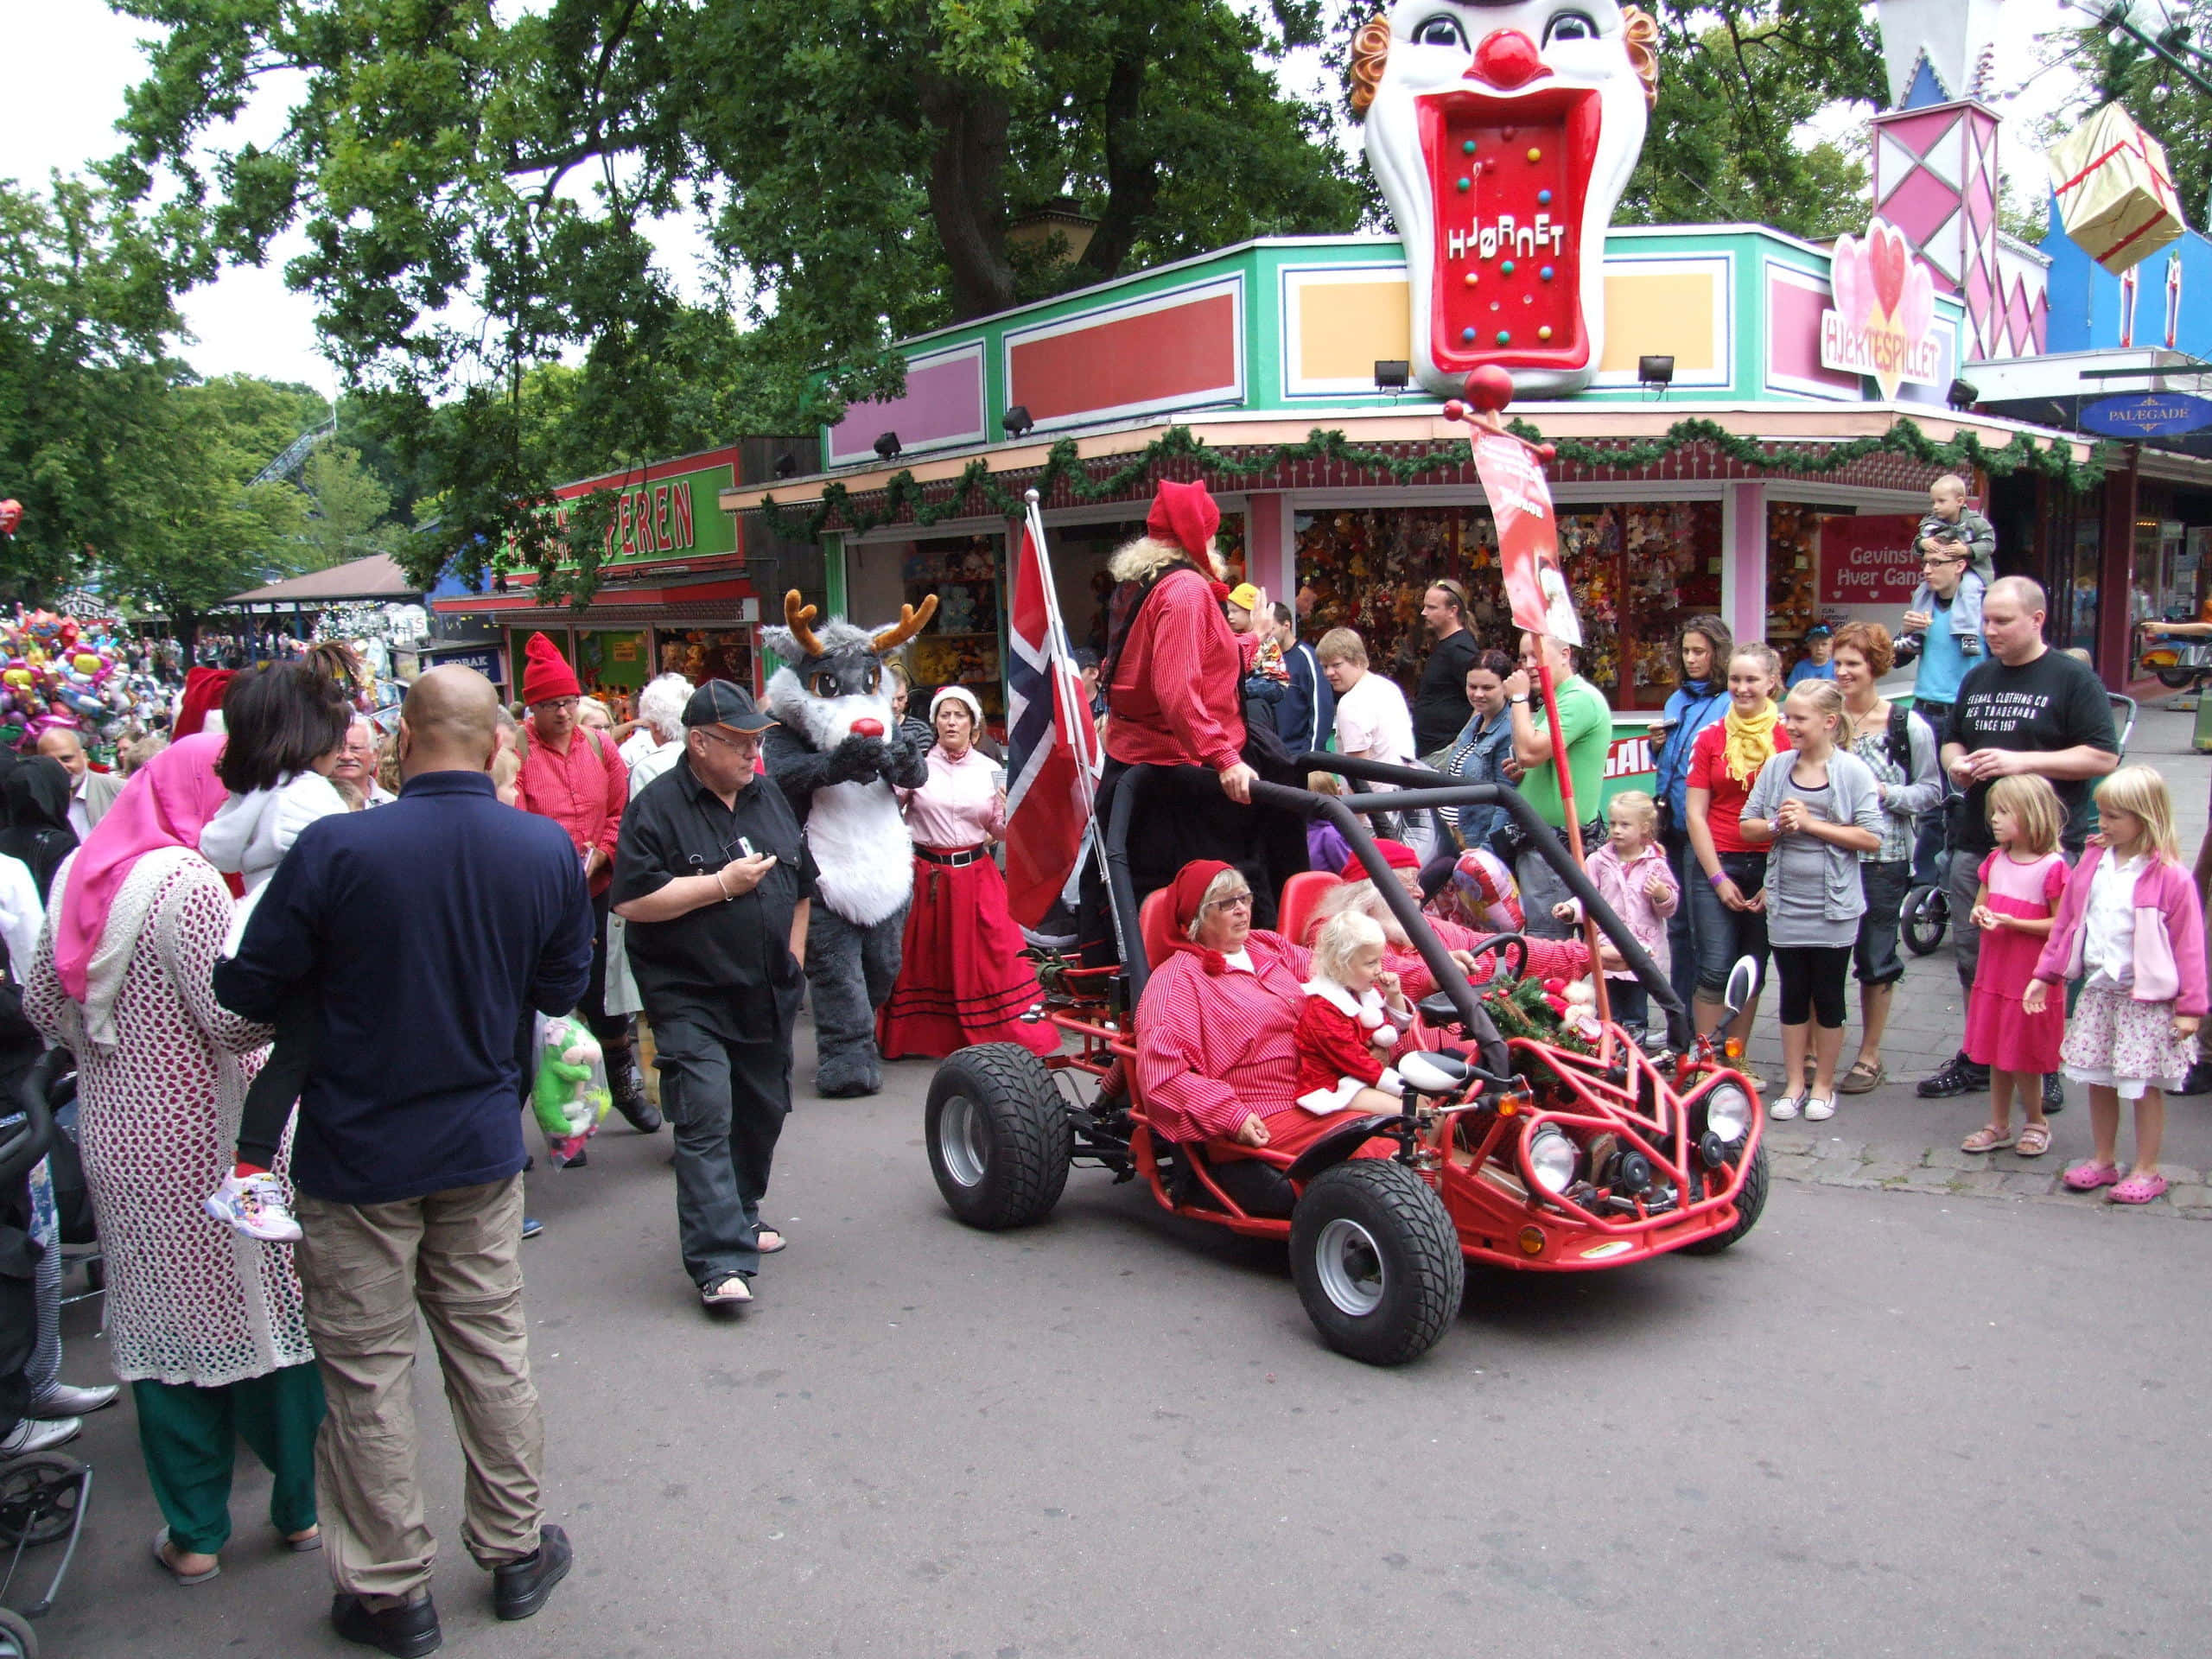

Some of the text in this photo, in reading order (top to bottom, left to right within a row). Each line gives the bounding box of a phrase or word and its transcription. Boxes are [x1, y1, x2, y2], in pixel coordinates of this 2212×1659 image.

[1448, 213, 1564, 259] HJØRNET
[1826, 317, 1939, 379] HJERTESPILLET
[2108, 408, 2190, 422] PALÆGADE
[1837, 569, 1878, 586] Hver
[1995, 692, 2032, 705] CLOTHING
[2034, 696, 2049, 708] CO
[1984, 706, 2037, 719] TRADEMARK
[1974, 720, 1998, 731] SINCE
